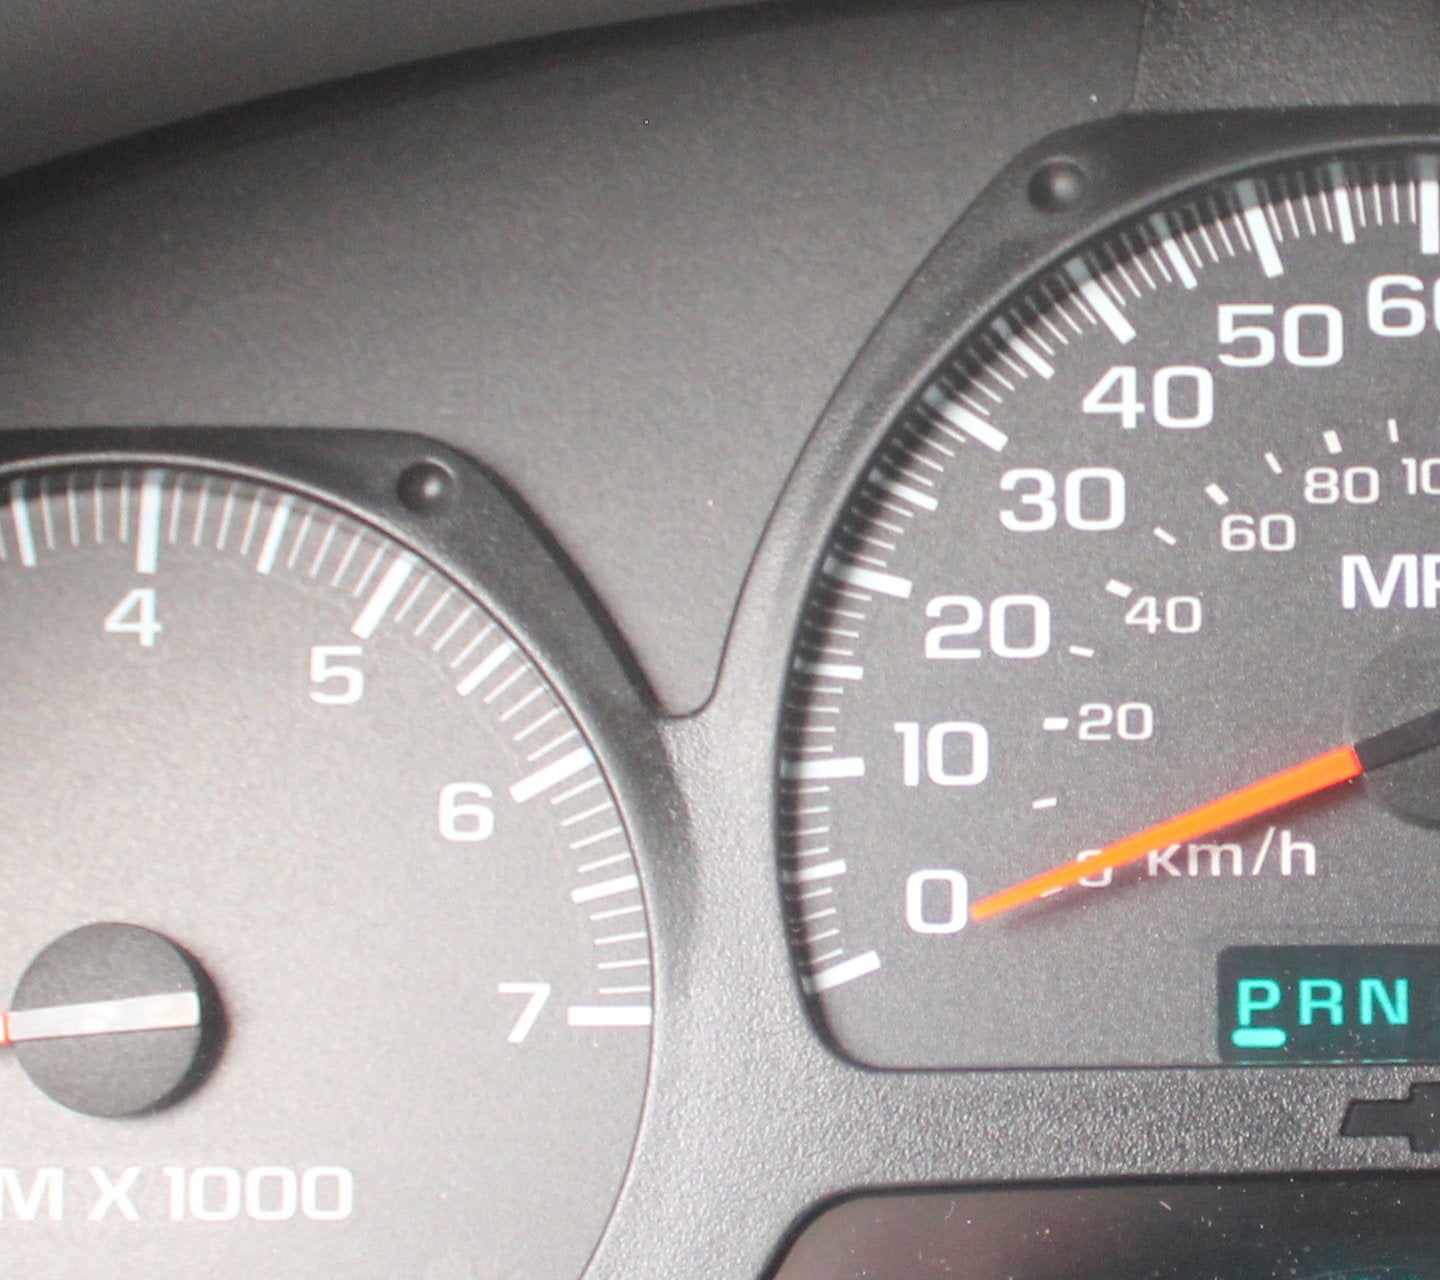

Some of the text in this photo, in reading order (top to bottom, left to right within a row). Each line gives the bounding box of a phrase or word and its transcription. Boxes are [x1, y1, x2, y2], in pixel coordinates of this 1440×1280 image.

[1216, 303, 1345, 369] 50
[1081, 364, 1215, 431] 40
[998, 466, 1127, 534] 30
[1302, 465, 1381, 506] 80
[1219, 512, 1297, 553] 60
[103, 587, 164, 649] 4
[923, 593, 1052, 661] 20
[1123, 595, 1203, 635] 40
[308, 644, 366, 706] 5
[1077, 701, 1155, 742] 20
[892, 720, 990, 788] 10
[438, 781, 496, 843] 6
[1146, 826, 1319, 879] km/h
[904, 867, 969, 935] 0
[496, 980, 553, 1044] 7
[87, 1165, 143, 1223] X
[162, 1164, 354, 1223] 1000
